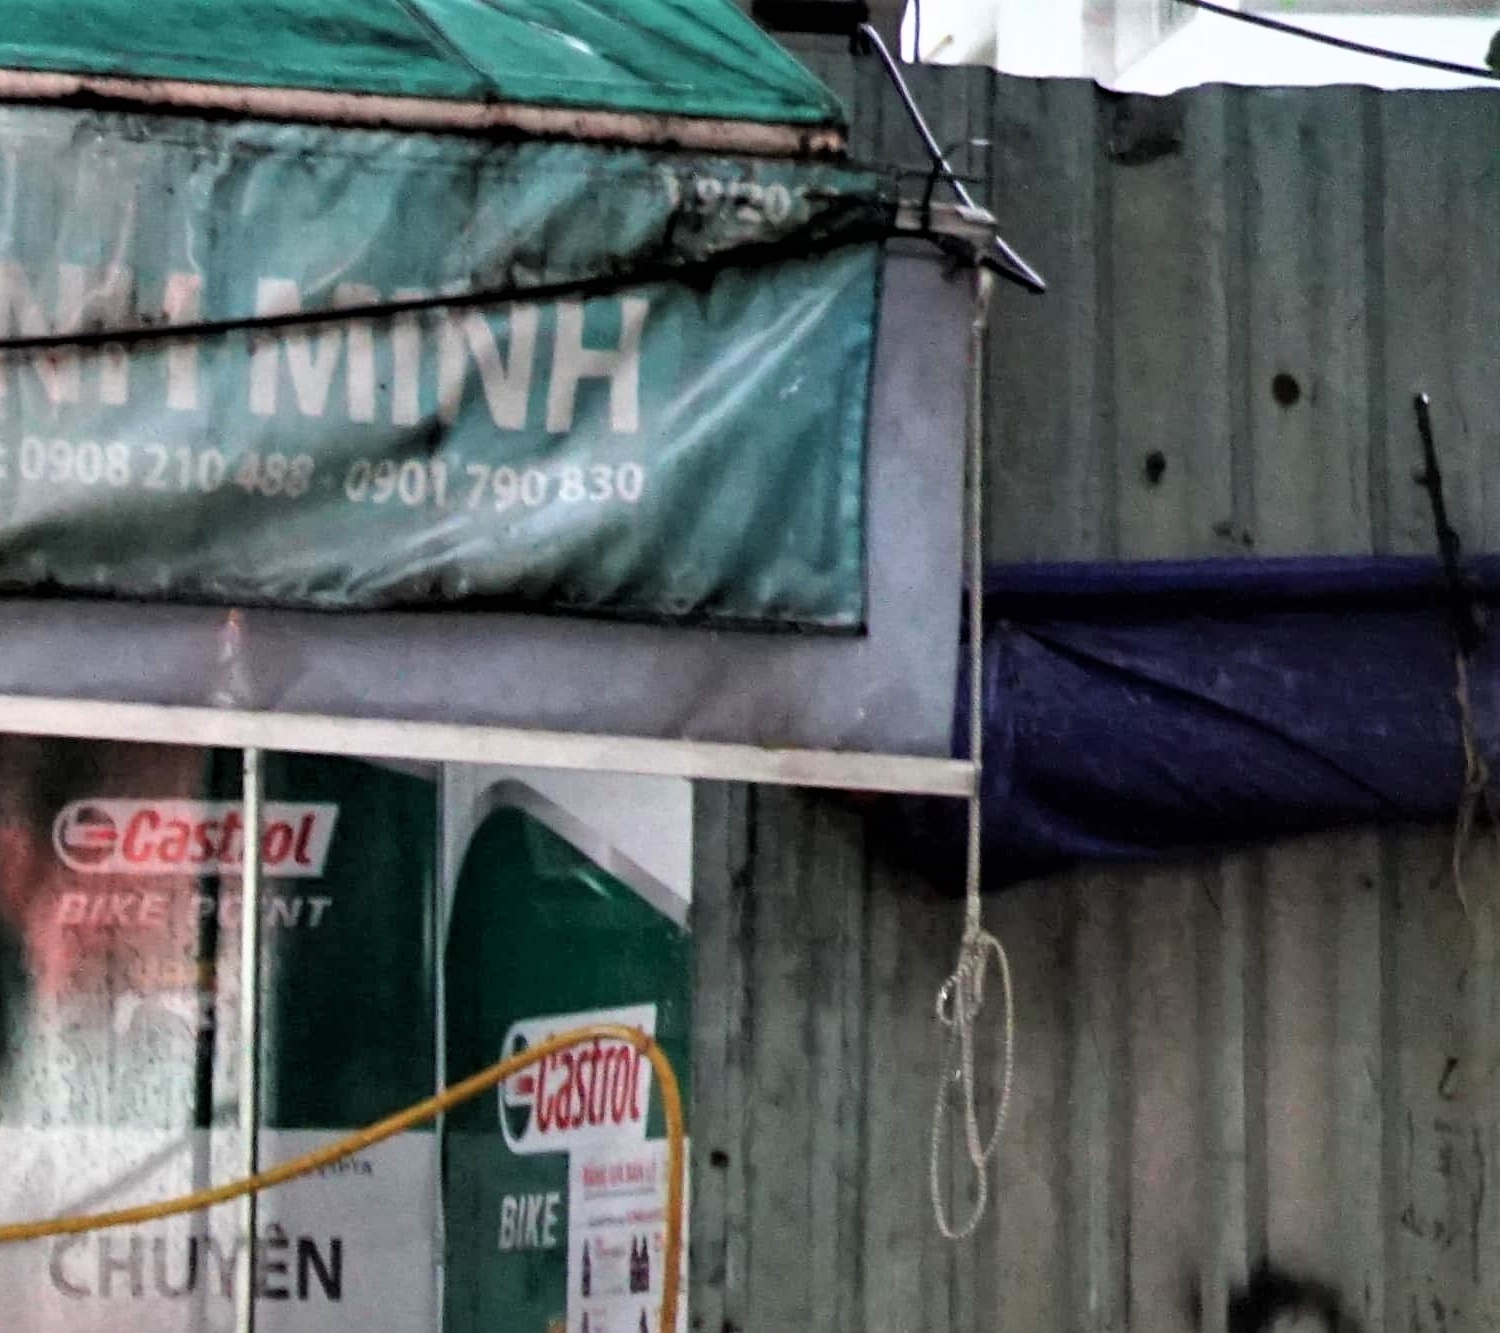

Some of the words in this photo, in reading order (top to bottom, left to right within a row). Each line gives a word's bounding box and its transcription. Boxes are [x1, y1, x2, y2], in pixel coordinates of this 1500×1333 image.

[250, 278, 650, 433] MINH
[20, 436, 130, 485] 0908
[143, 443, 226, 493] 210
[344, 458, 446, 508] 0901
[465, 465, 546, 511] 790
[558, 460, 645, 503] 830
[121, 805, 315, 865] Castol
[190, 894, 333, 929] PONT
[500, 1191, 561, 1252] BIKE
